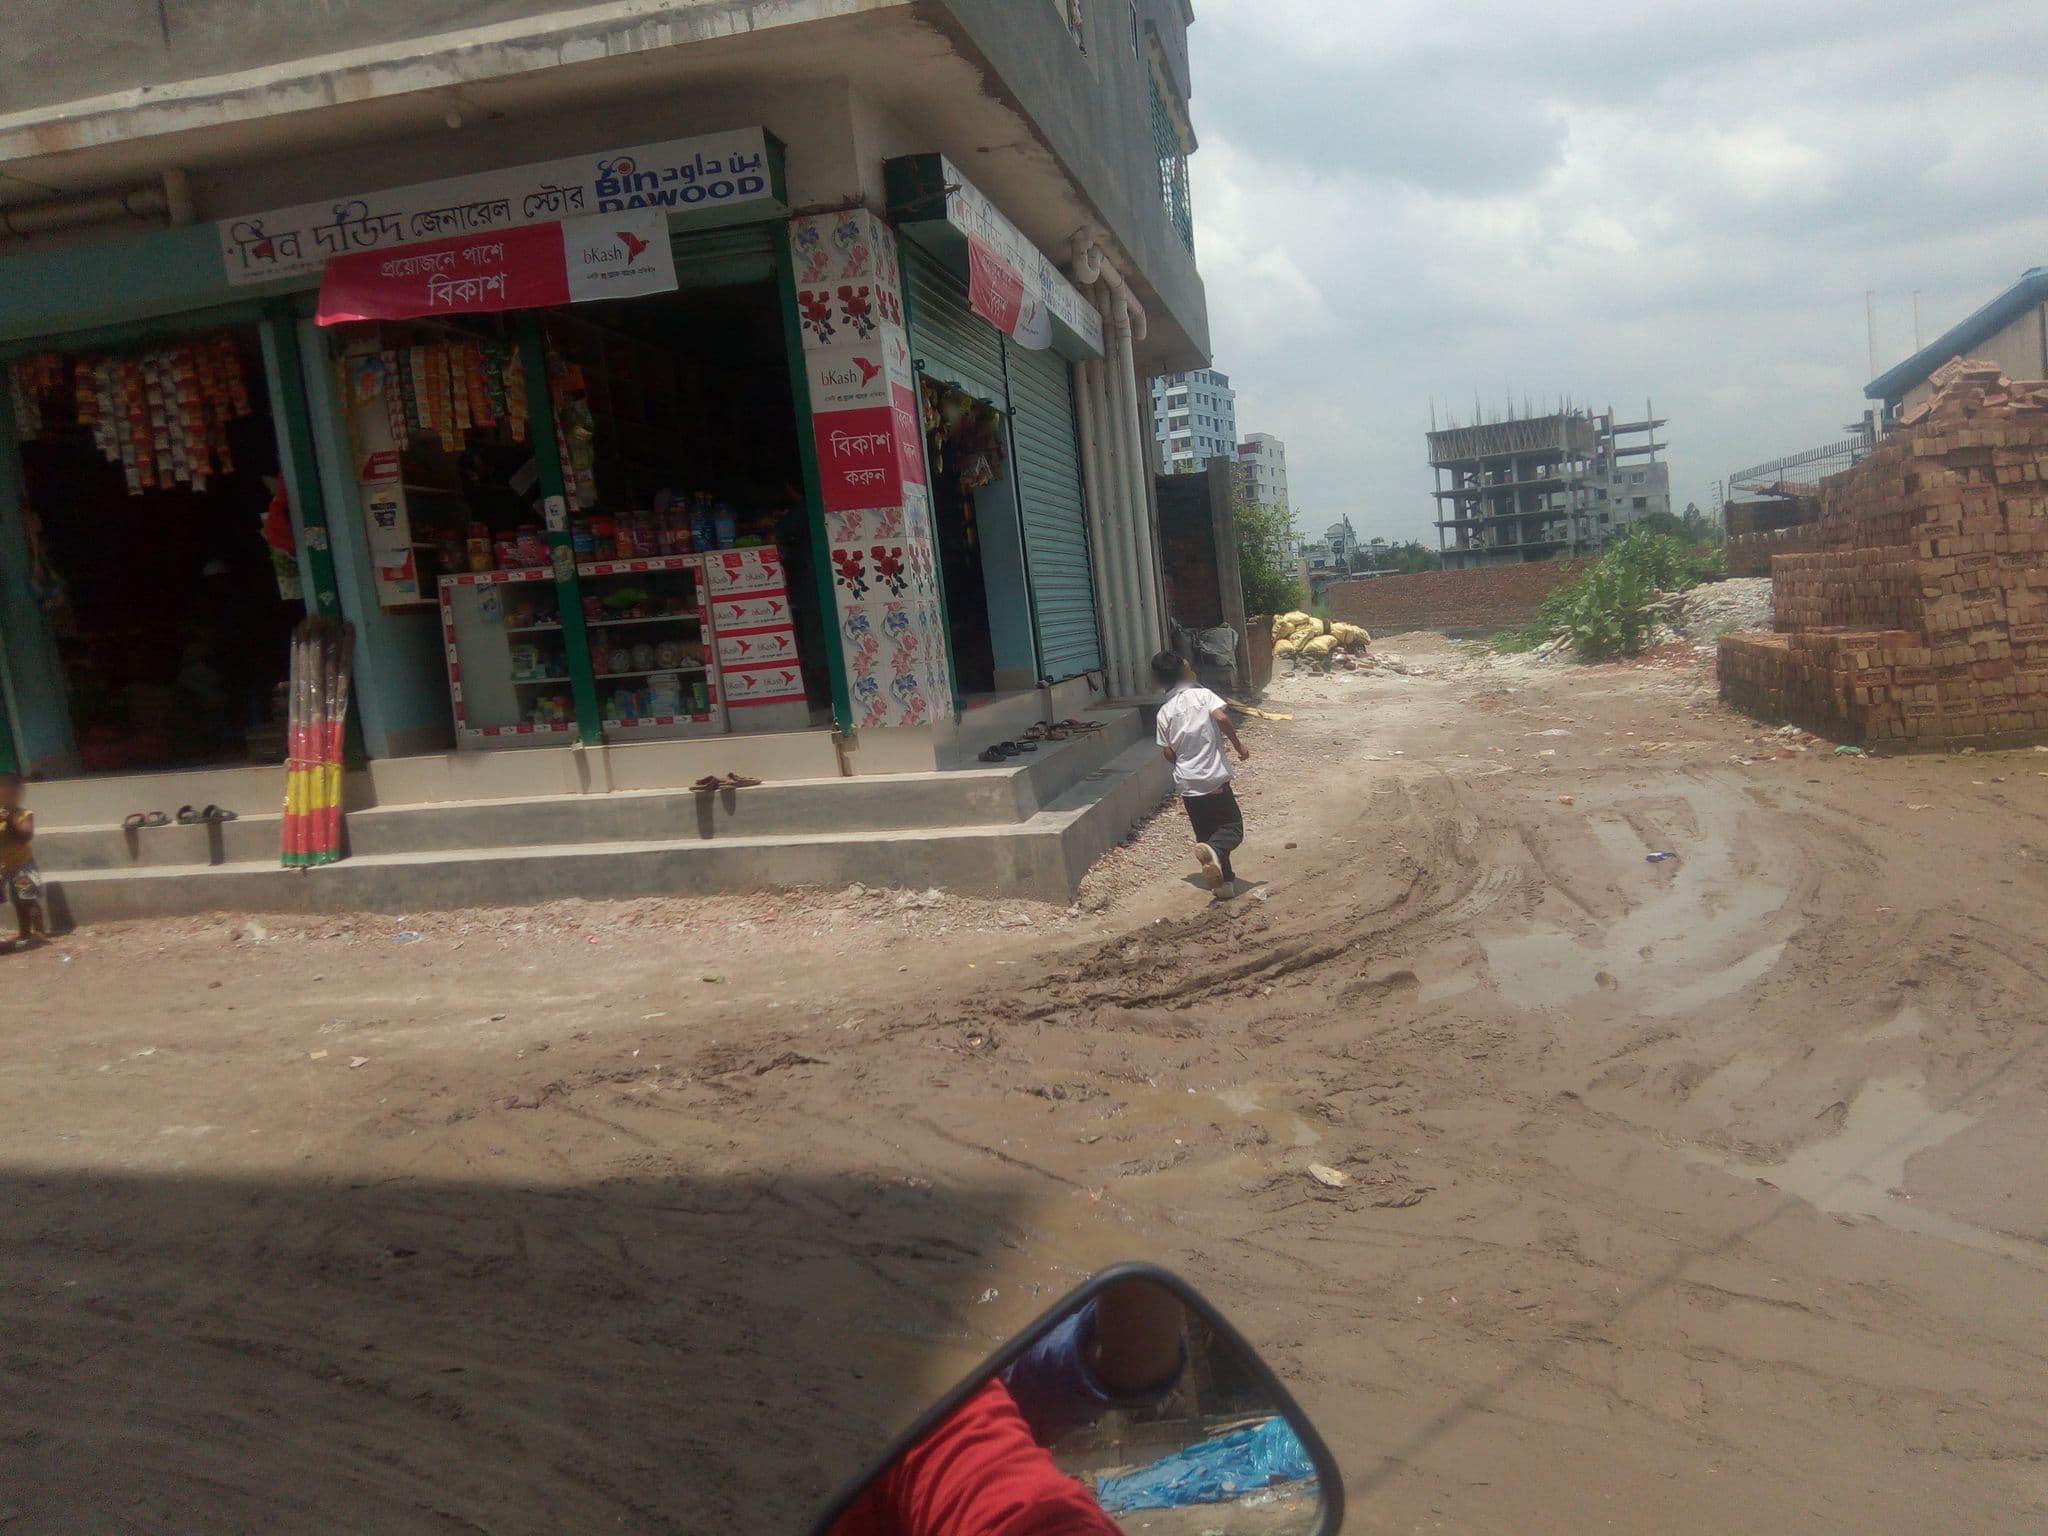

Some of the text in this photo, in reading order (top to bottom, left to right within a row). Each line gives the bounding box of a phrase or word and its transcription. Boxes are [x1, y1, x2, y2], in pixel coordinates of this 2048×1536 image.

[599, 176, 764, 213] DAWOOD
[231, 218, 302, 268] বিন
[411, 198, 511, 237] জেনারেল
[523, 184, 585, 218] স্টোর
[382, 242, 504, 278] প্রয়োজনে পাশে
[584, 246, 622, 265] bKash
[428, 272, 507, 306] বিকাশ
[821, 369, 857, 386] bKash
[830, 430, 892, 457] বিকাশ
[843, 468, 886, 486] করুন
